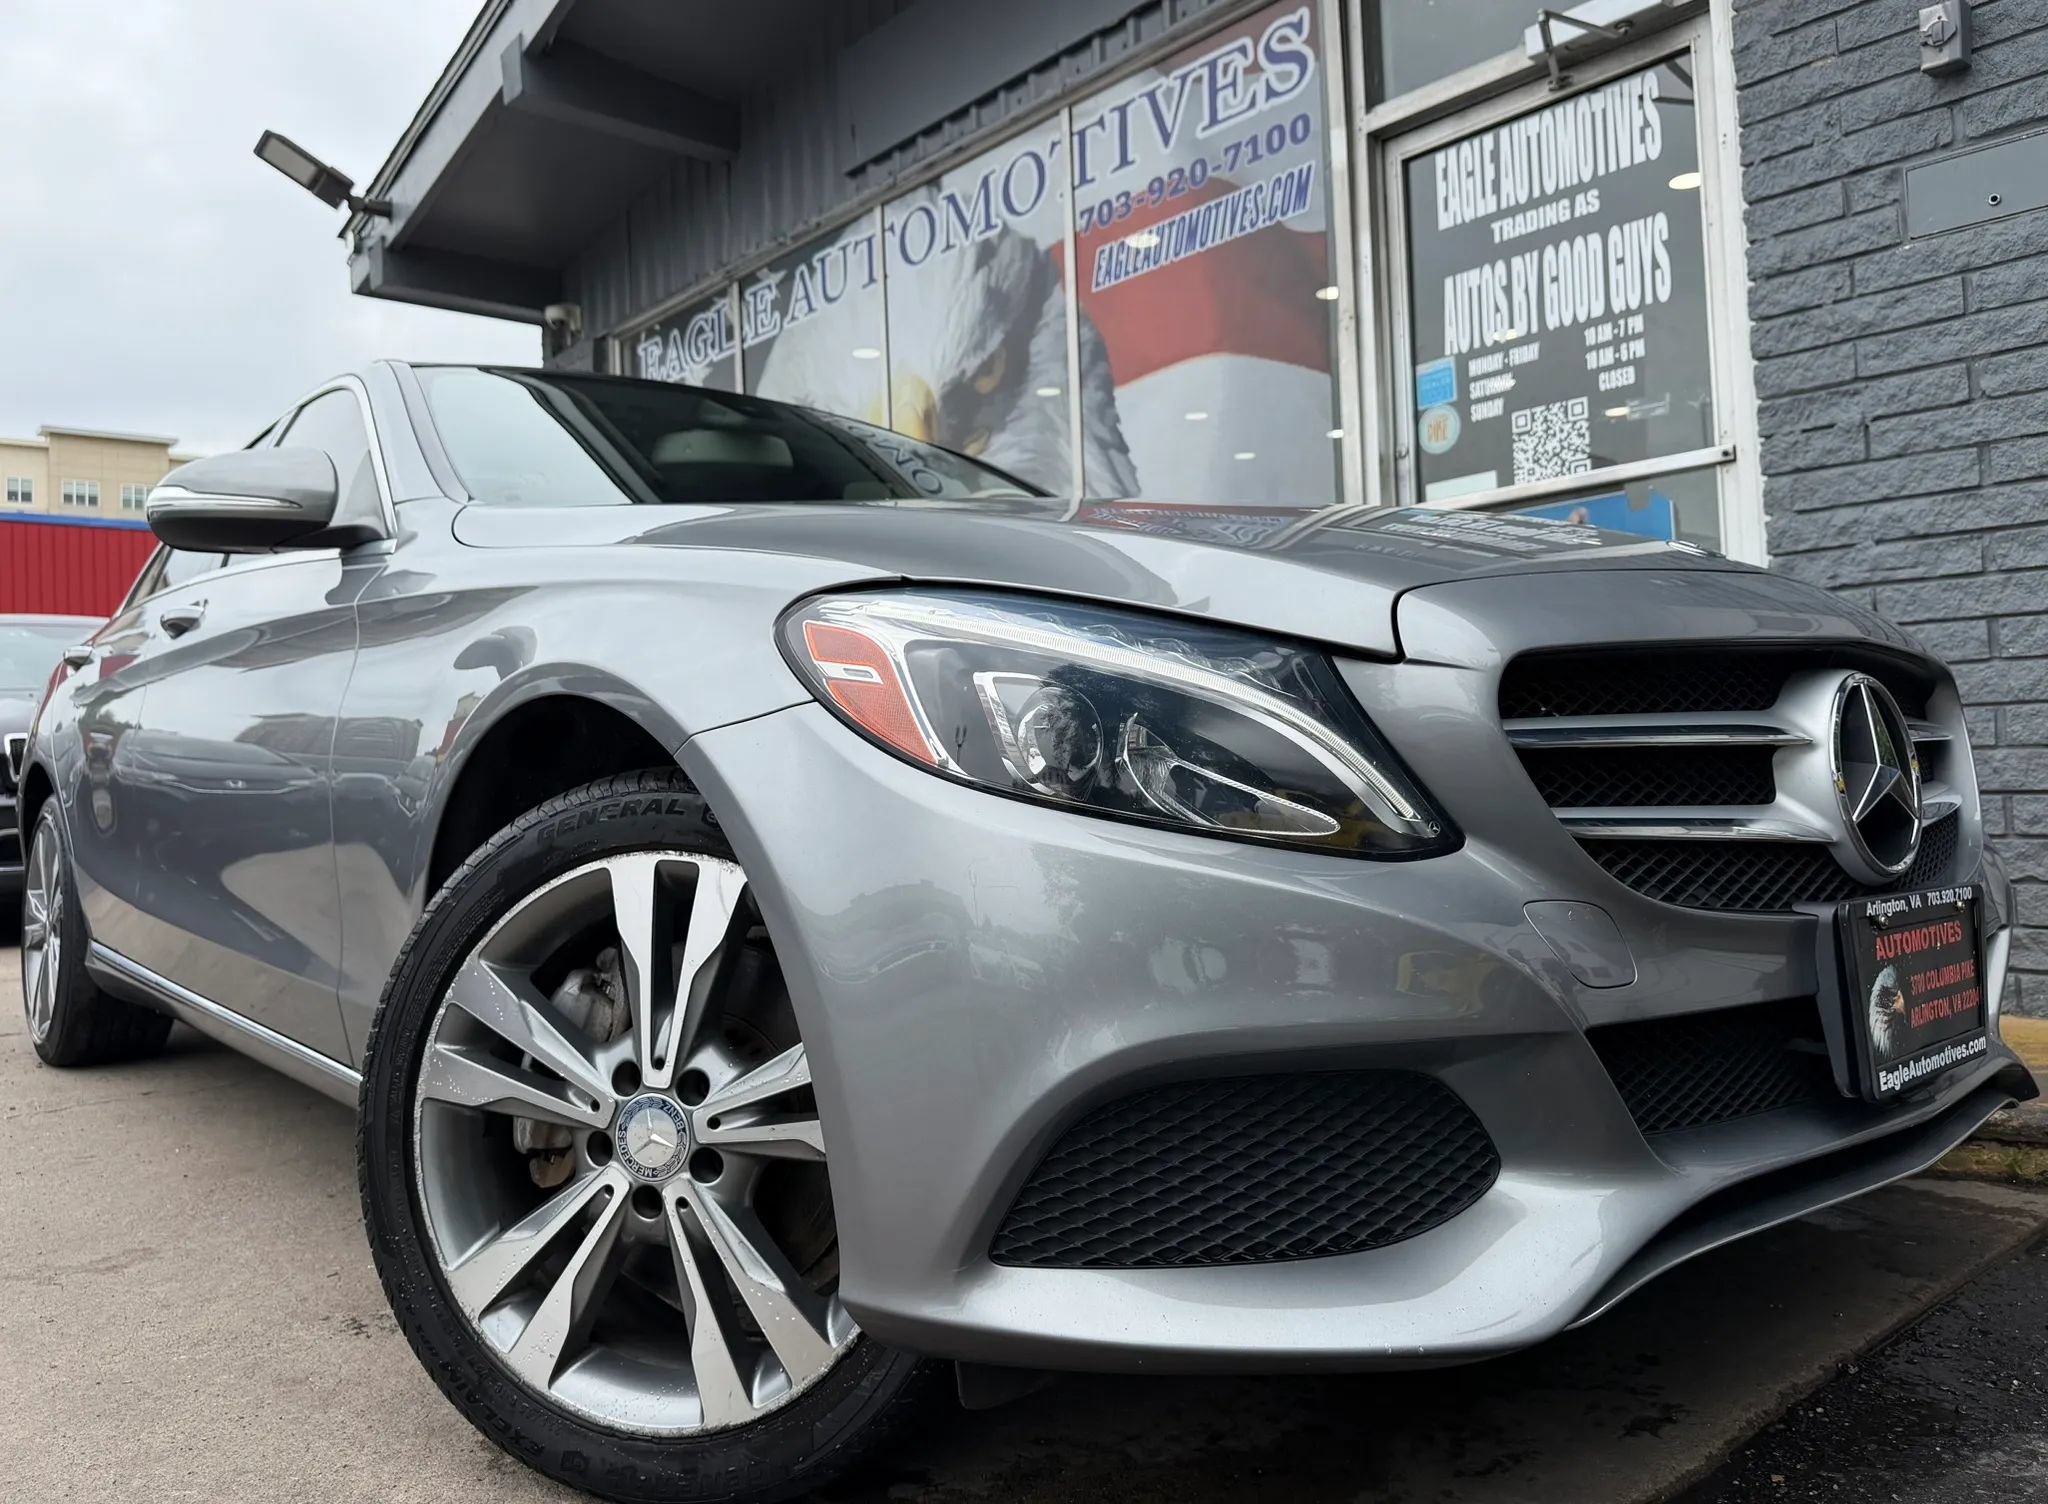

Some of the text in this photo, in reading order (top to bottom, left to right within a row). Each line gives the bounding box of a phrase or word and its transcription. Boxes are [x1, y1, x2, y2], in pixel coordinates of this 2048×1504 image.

[1434, 71, 1662, 231] EAGLE AUTOMOTIVES
[638, 7, 1316, 380] EAGLE AUTOMOTIVES
[1079, 112, 1312, 236] 703-920-7100
[1092, 161, 1315, 292] EAGLEAUTOMOTIVES.COM
[1490, 188, 1600, 244] TRADING AS
[1444, 212, 1671, 356] AUTOS BY GOOD GUYS
[1584, 326, 1596, 346] 10
[1597, 322, 1613, 344] AM
[1618, 318, 1625, 338] 7
[1627, 313, 1644, 336] PM
[1468, 351, 1504, 378] MONDAY
[1509, 341, 1540, 367] FRIDAY
[1585, 350, 1597, 370] 10
[1629, 338, 1645, 360] PM
[1599, 365, 1636, 392] CLOSED
[1470, 397, 1504, 423] SUNDAY
[536, 798, 687, 846] GENERAL
[1866, 886, 1972, 917] Arlington, VA 703.920.7100
[1876, 920, 1963, 960] AUTOMOTIVES
[1926, 963, 1961, 990] COLUMBIA
[1961, 959, 1975, 980] PIKE
[1952, 993, 1962, 1013] VA
[1879, 1035, 1987, 1092] EagleAutomotives.com
[618, 1101, 685, 1177] MERCEDES BENZ
